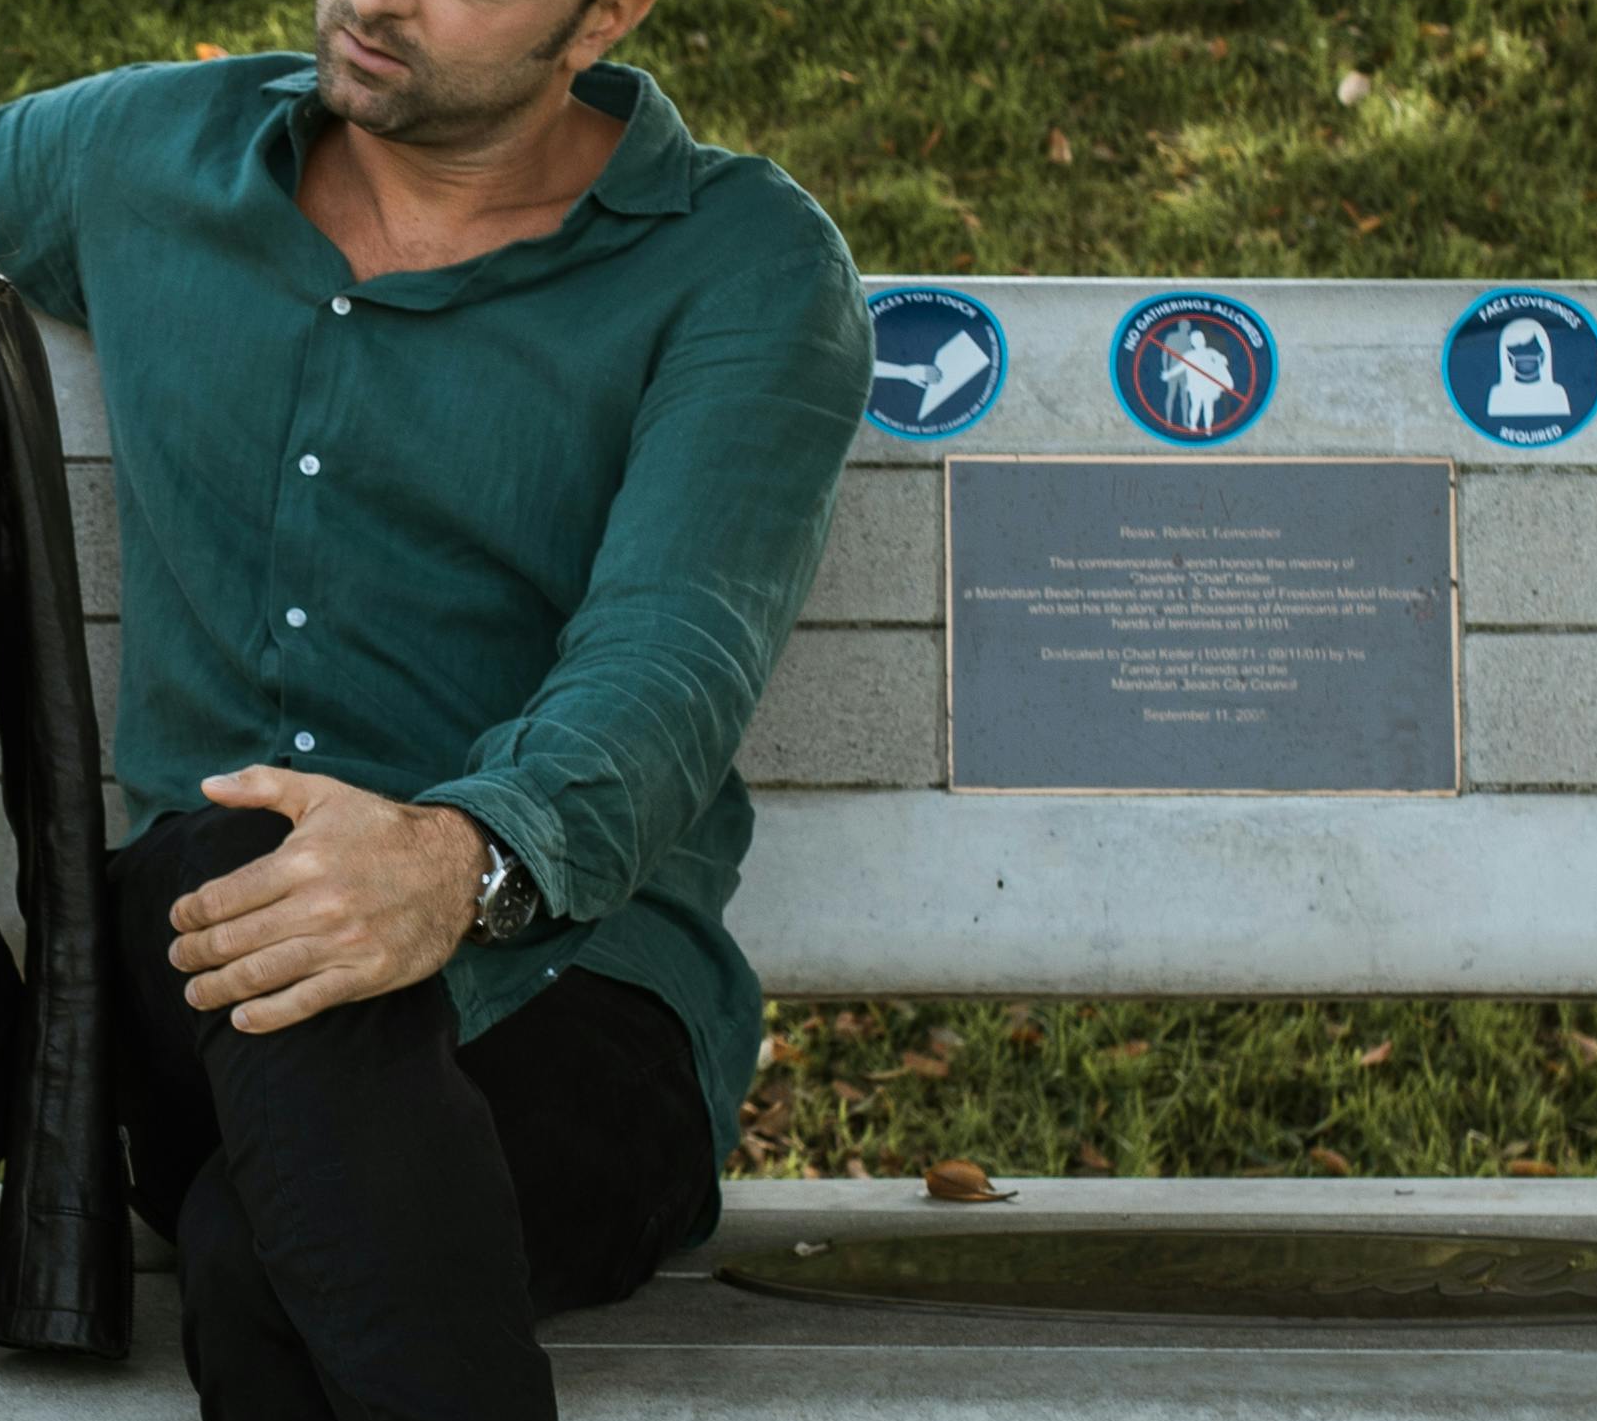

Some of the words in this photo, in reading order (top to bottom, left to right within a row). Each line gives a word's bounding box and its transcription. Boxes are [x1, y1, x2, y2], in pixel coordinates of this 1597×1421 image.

[904, 292, 933, 304] YOU
[936, 294, 979, 320] TOUCH
[1477, 297, 1509, 323] FACE
[1510, 296, 1583, 330] COVERINGS
[1123, 329, 1141, 353] NO
[1136, 299, 1211, 332] GATHERINGS
[1213, 303, 1265, 349] ALLOWED
[1499, 424, 1563, 444] REQUIRED
[975, 586, 1042, 599] Manhattan
[1043, 586, 1084, 599] Beach
